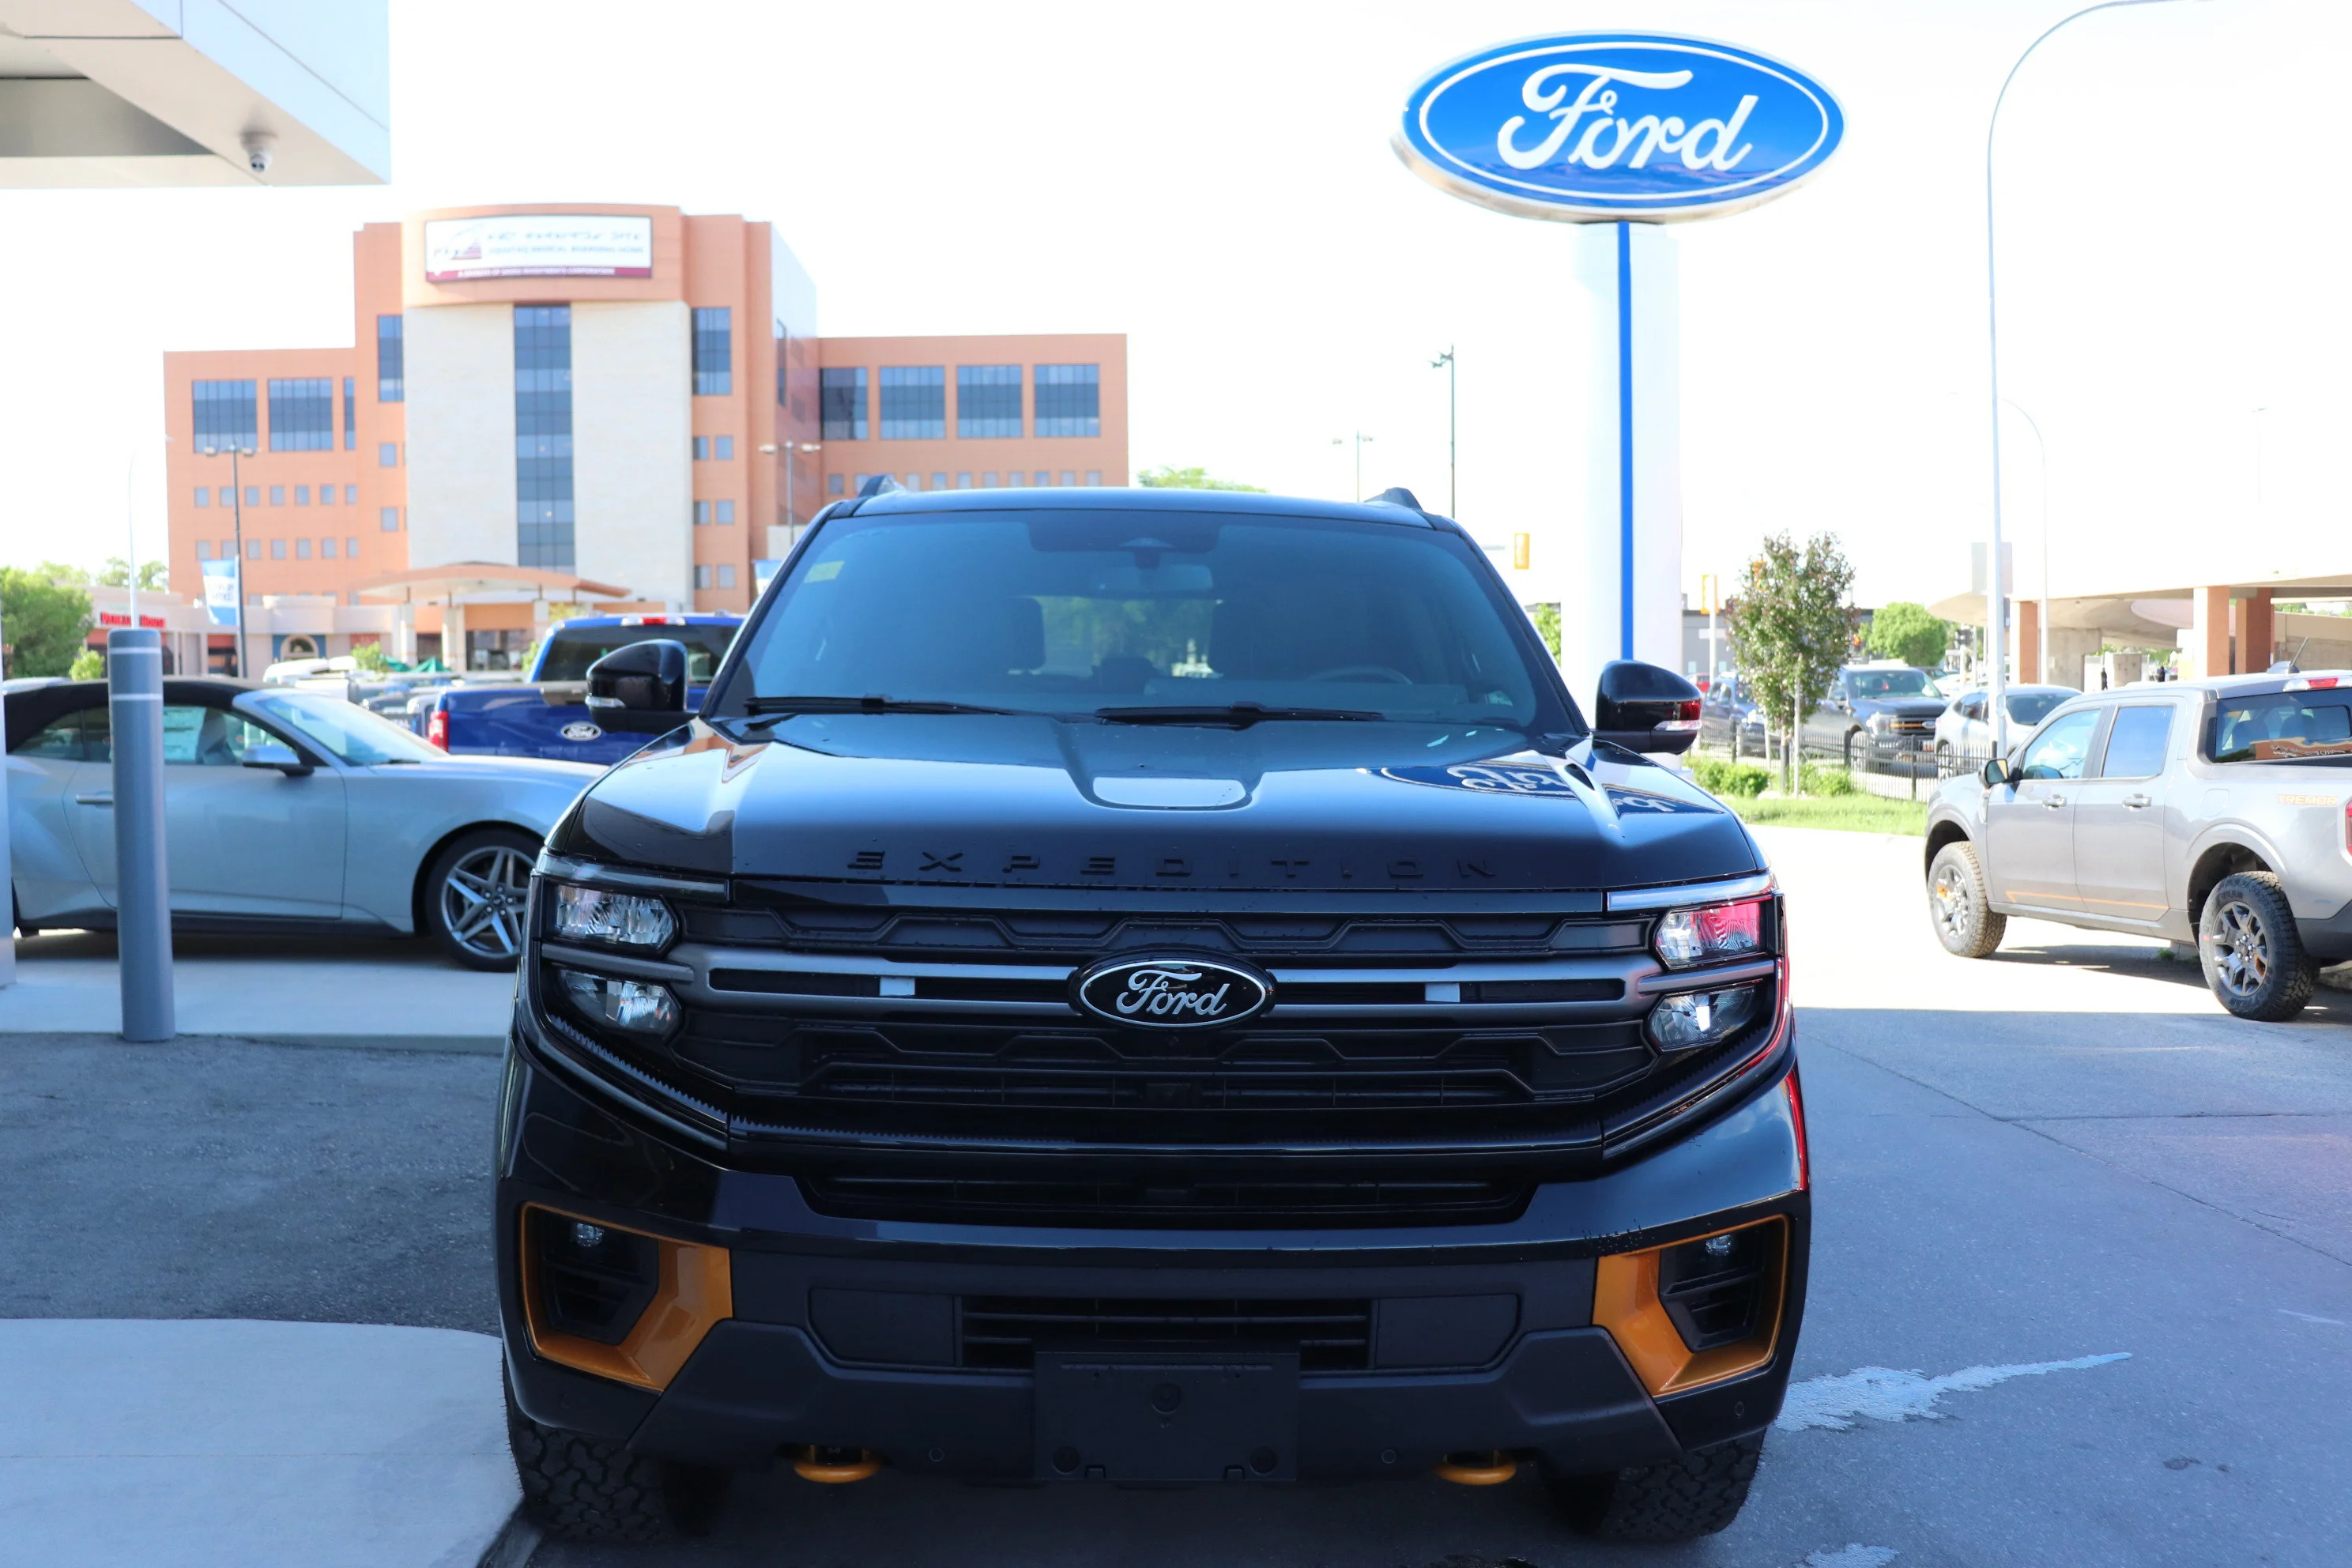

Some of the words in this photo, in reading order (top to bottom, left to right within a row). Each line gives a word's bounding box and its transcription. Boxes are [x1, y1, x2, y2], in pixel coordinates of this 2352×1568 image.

[1497, 62, 1759, 171] Ford
[2276, 793, 2339, 806] TREMOR
[846, 850, 1497, 878] EXPEDITION
[1115, 969, 1231, 1016] Ford
